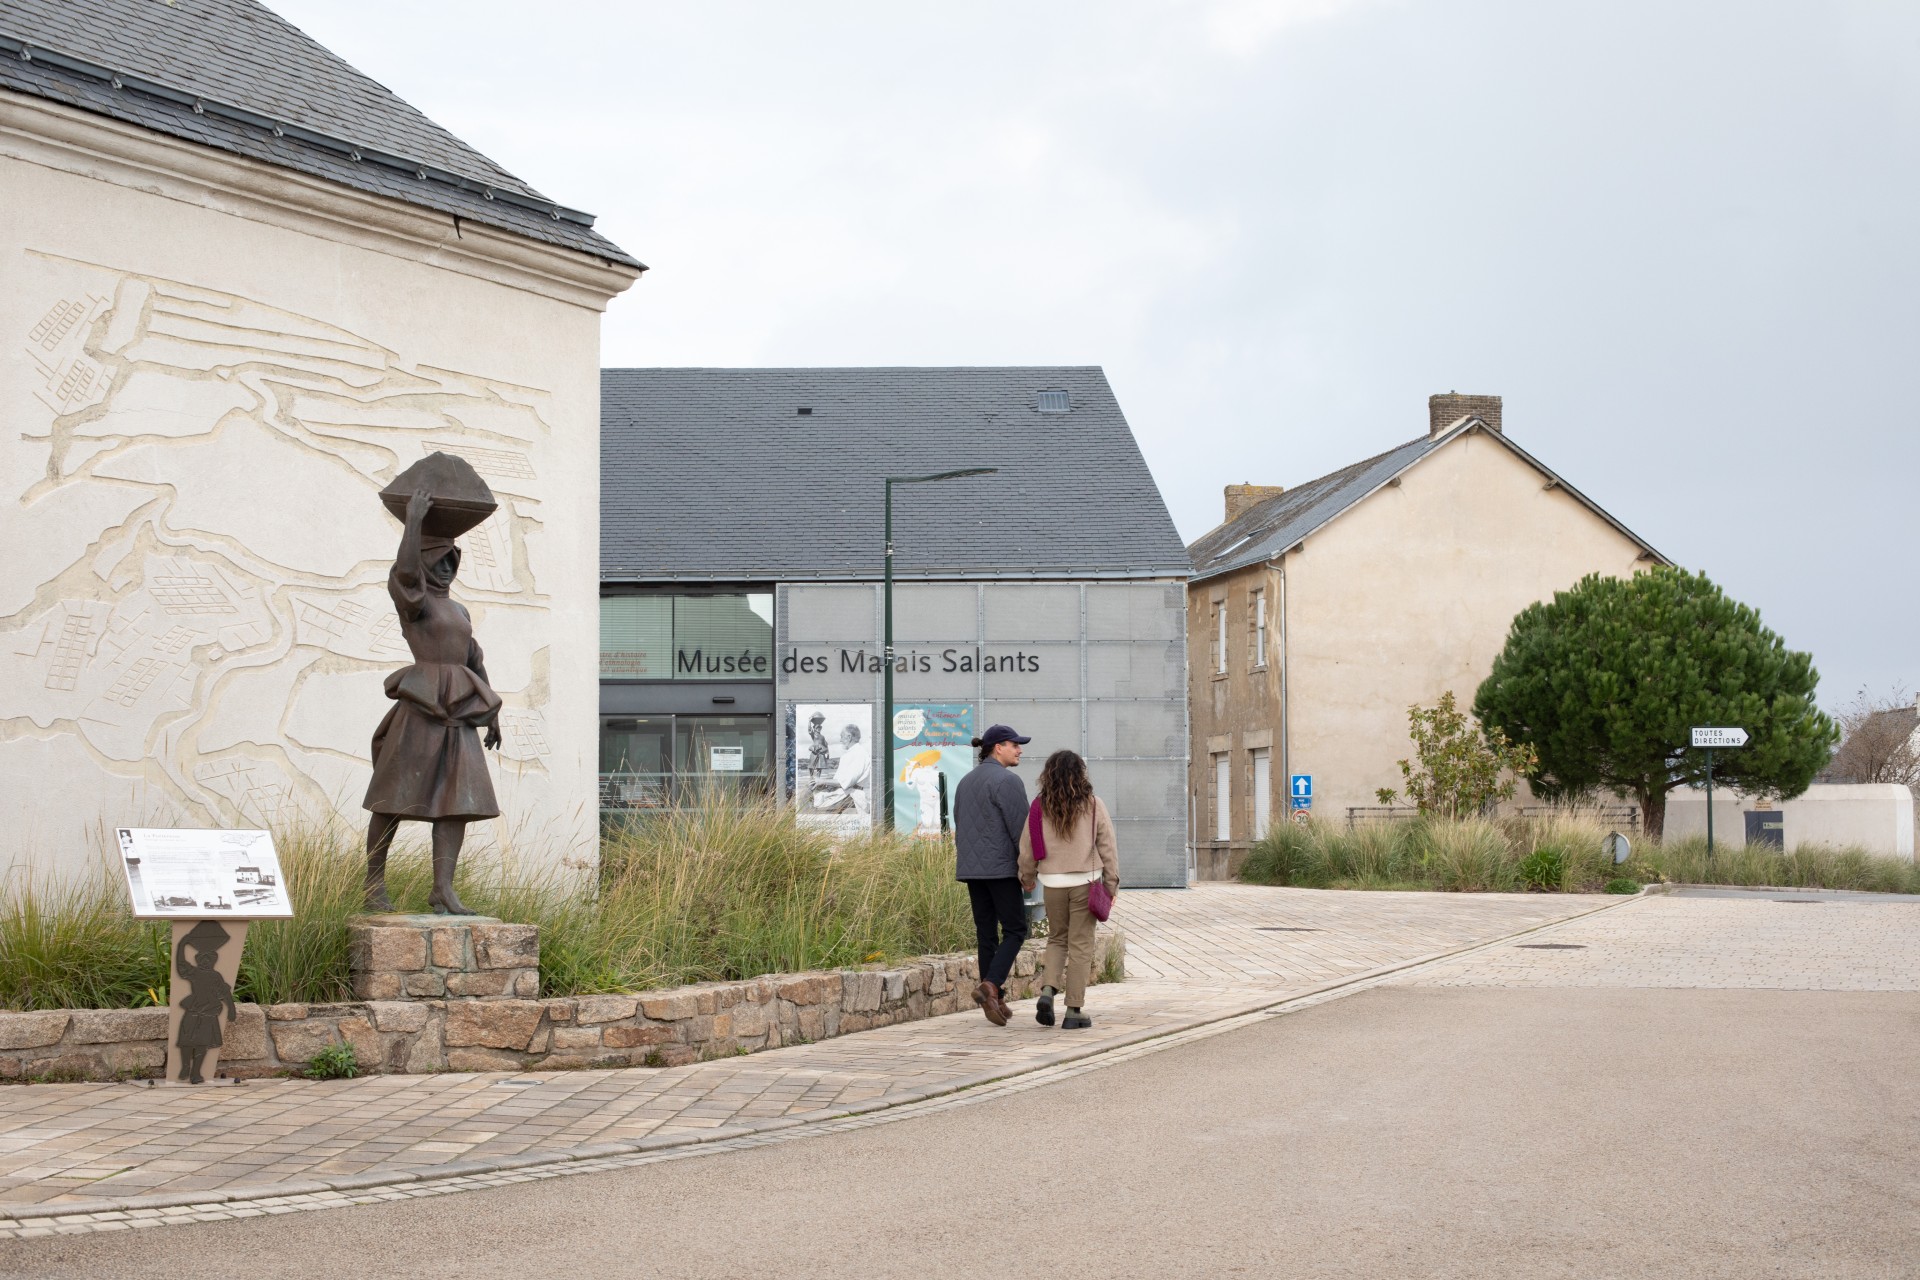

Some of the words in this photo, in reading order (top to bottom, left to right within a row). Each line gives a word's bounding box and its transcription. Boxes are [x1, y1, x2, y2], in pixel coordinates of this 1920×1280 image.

[678, 648, 767, 673] Musée
[782, 647, 828, 673] des
[841, 649, 931, 673] Maais
[942, 646, 1040, 673] Salants
